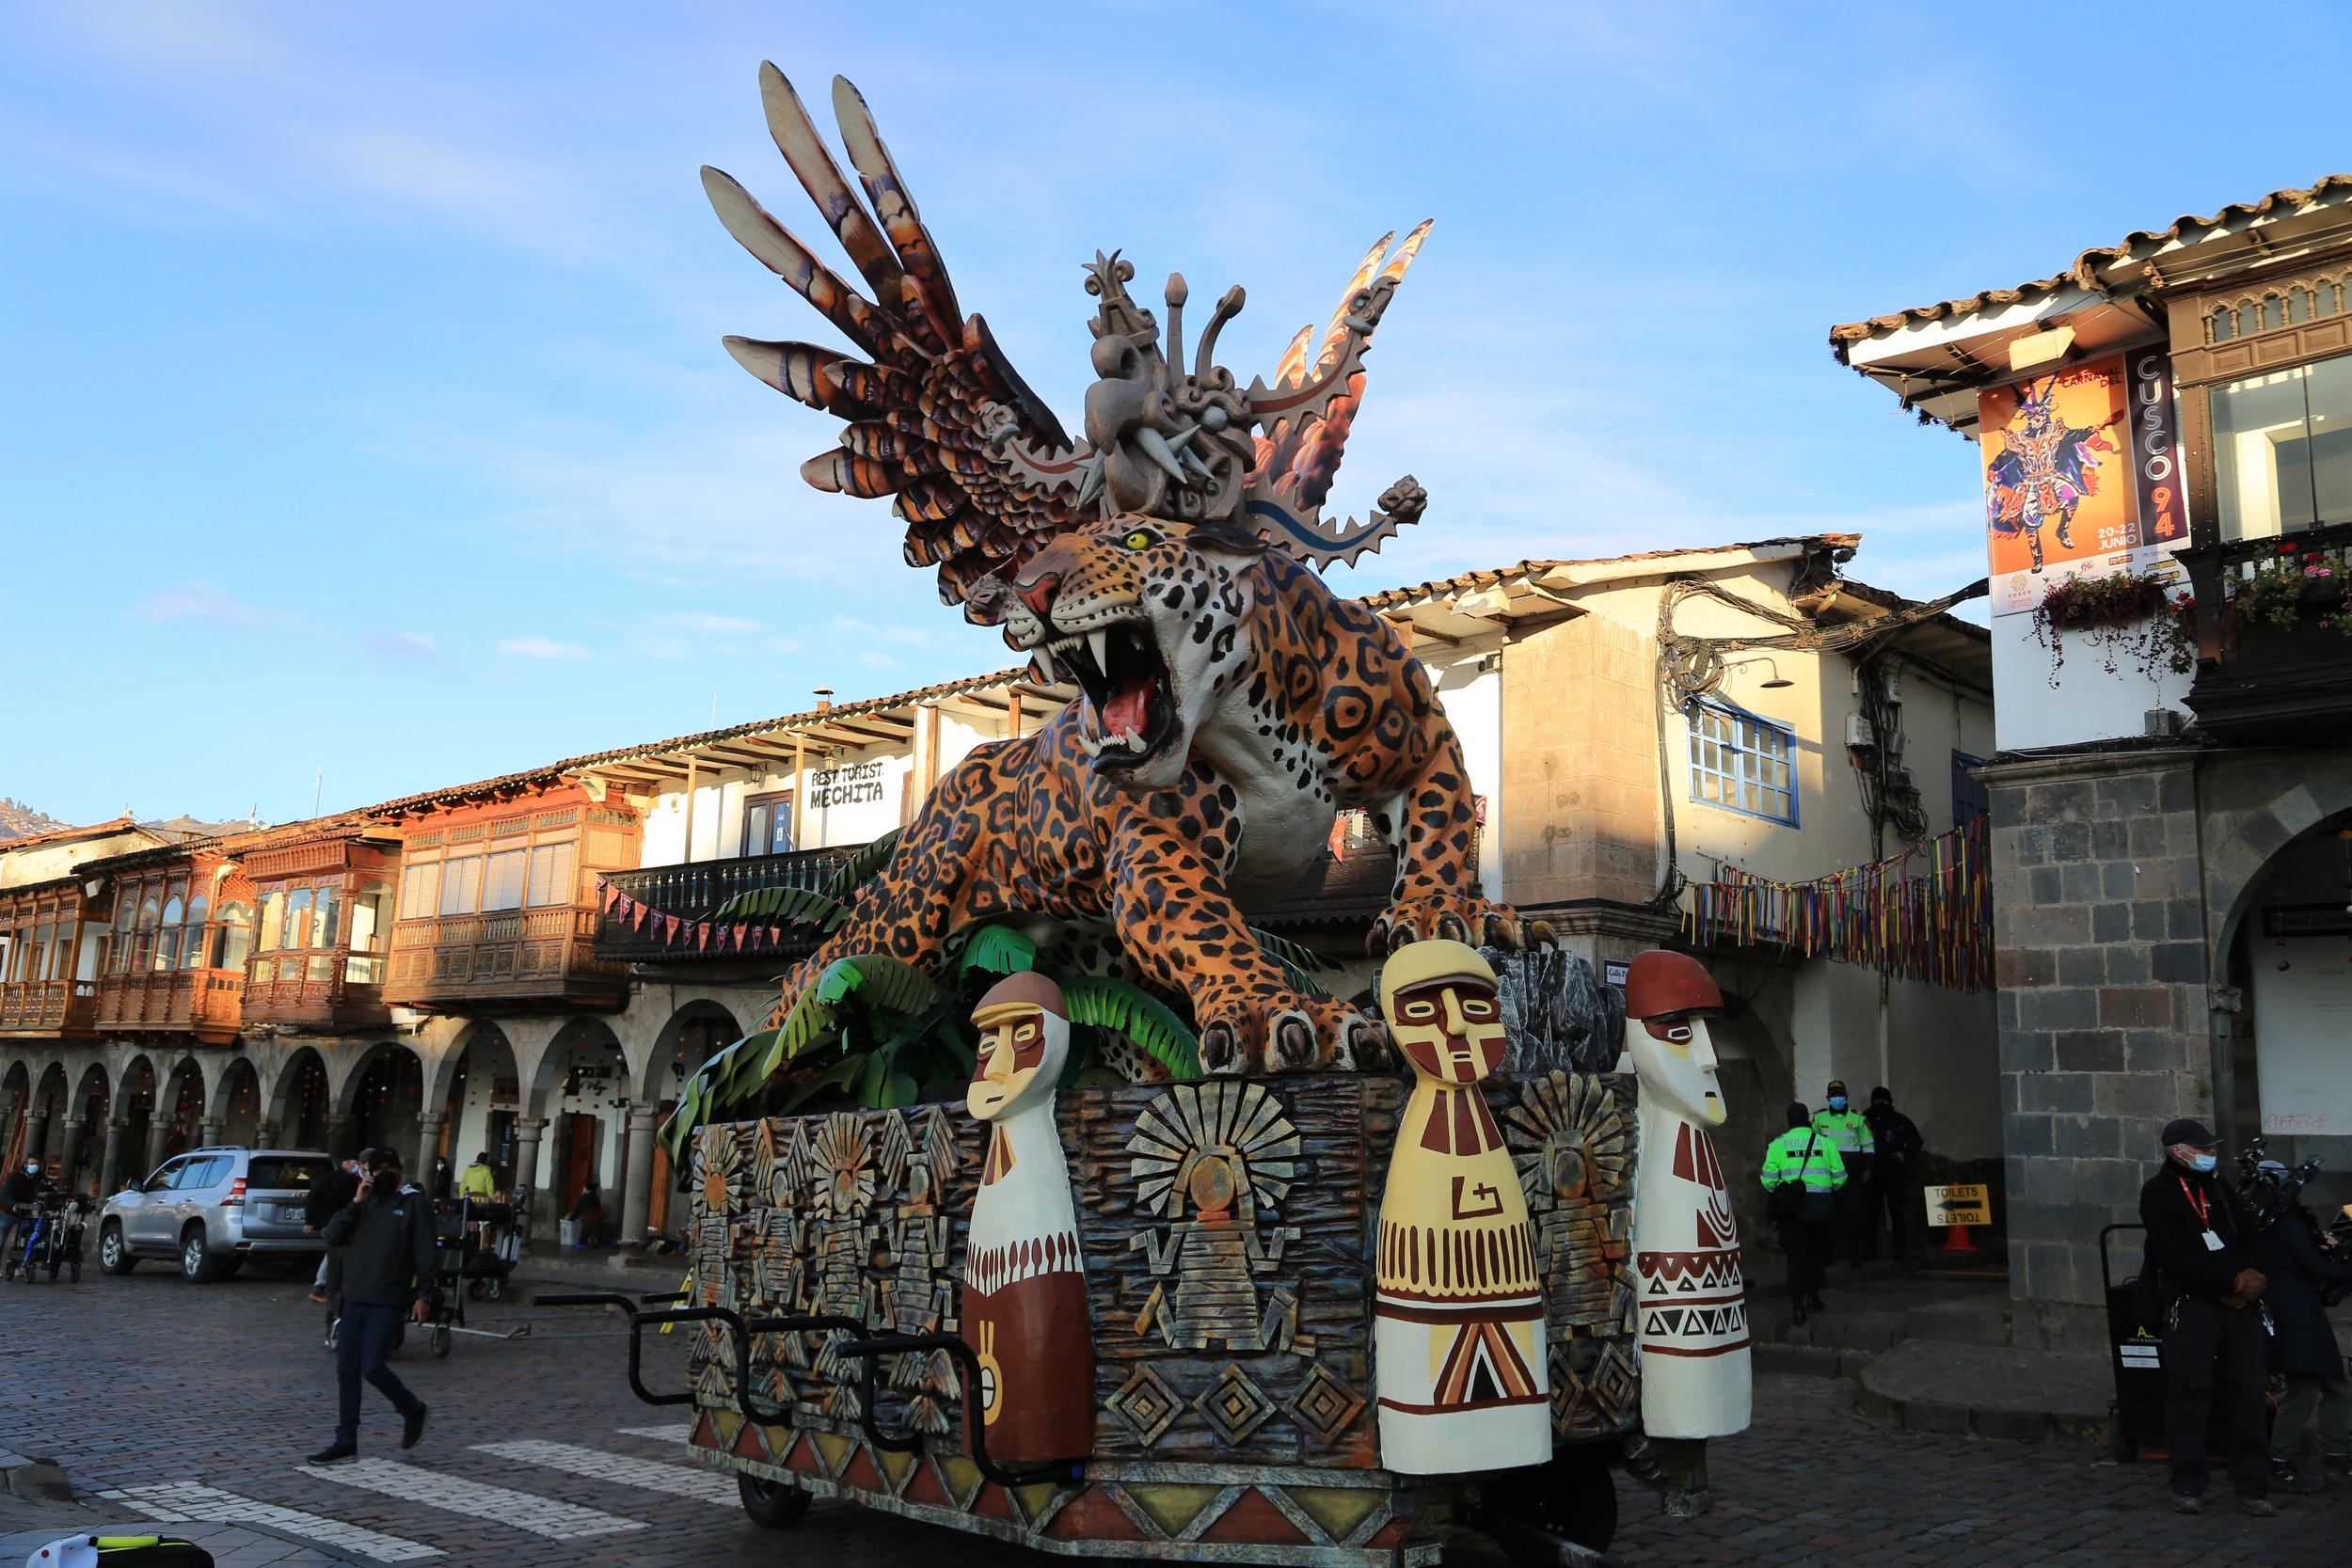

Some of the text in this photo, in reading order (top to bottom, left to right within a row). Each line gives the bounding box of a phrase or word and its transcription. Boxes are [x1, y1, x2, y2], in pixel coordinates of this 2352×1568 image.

[2061, 367, 2121, 388] CARNAVAL
[2100, 375, 2122, 388] DEL
[2137, 356, 2172, 481] CUSCO
[2152, 486, 2175, 537] 94
[2097, 522, 2136, 539] 20-22
[2098, 533, 2137, 550] JUNIO
[2008, 590, 2032, 598] CUSCO
[812, 768, 840, 787] REST.
[810, 781, 883, 809] MECHITA
[1608, 968, 1621, 977] Calle
[1934, 1187, 1979, 1198] TOILETS
[1937, 1212, 1981, 1224] TOILETS
